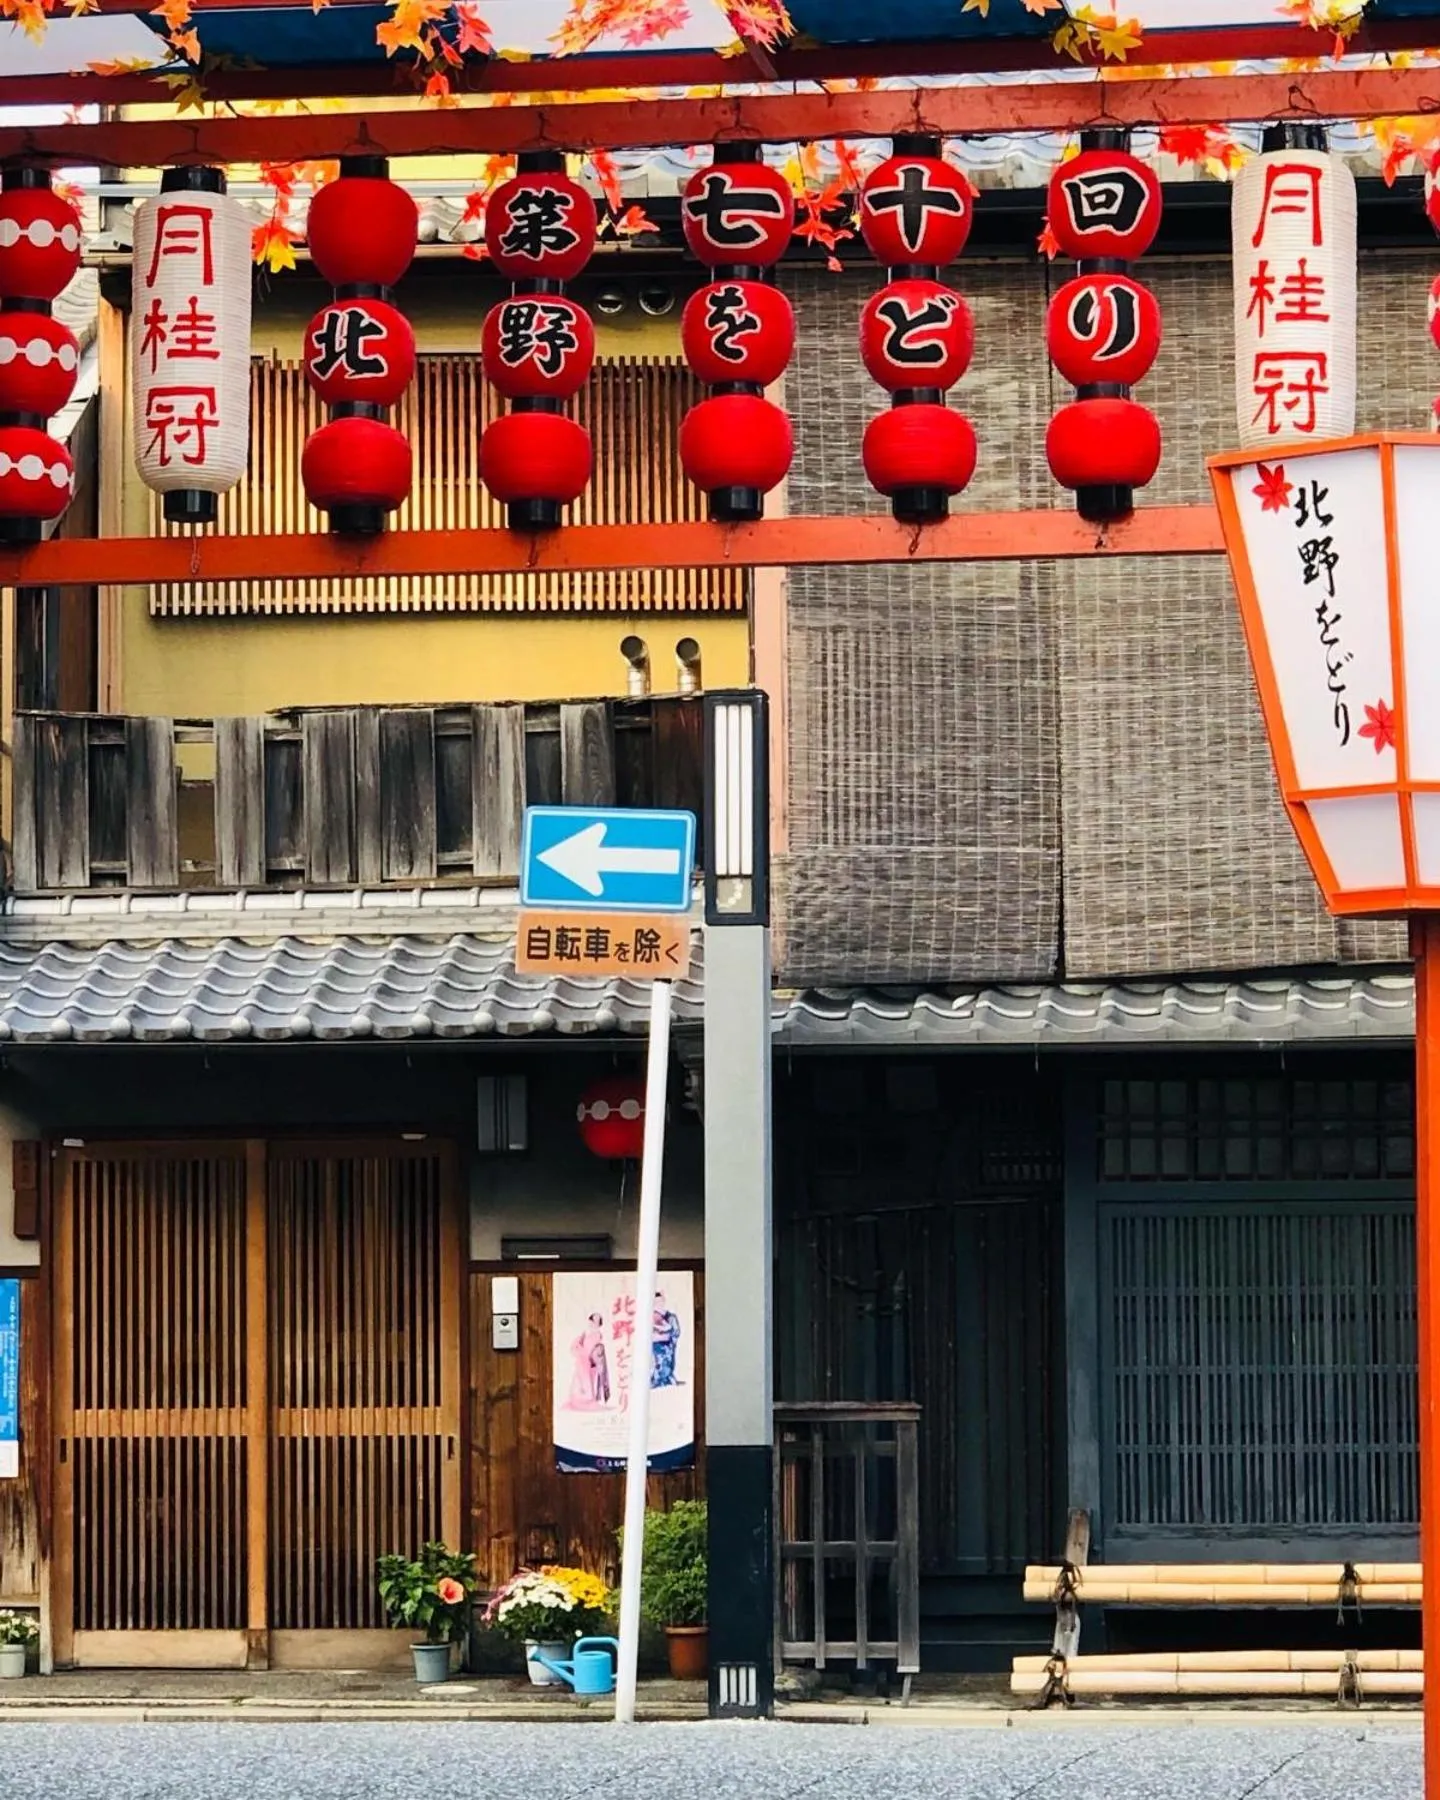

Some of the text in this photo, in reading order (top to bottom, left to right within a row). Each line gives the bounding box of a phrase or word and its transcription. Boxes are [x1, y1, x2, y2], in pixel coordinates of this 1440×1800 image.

[140, 204, 221, 468] 月桂冠
[1246, 163, 1331, 435] 月桂冠
[1294, 480, 1354, 747] 北野をどり
[526, 925, 680, 965] 自転車を除く
